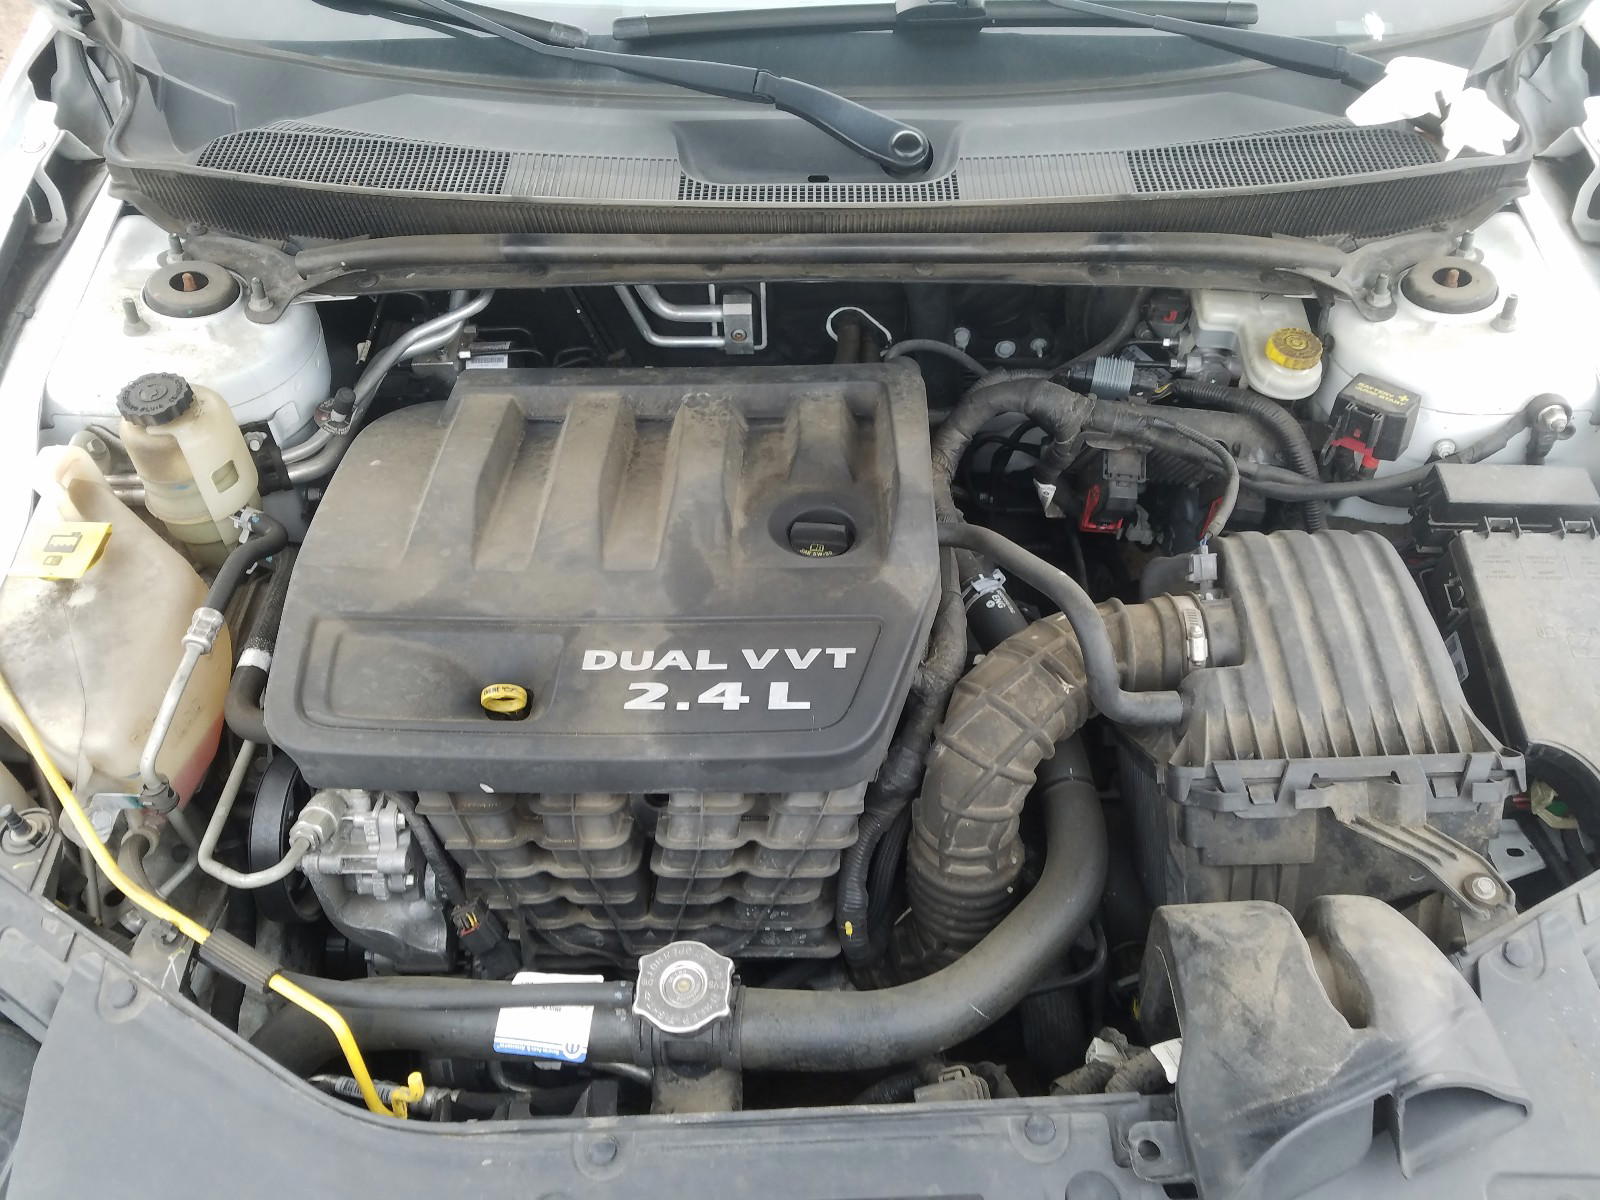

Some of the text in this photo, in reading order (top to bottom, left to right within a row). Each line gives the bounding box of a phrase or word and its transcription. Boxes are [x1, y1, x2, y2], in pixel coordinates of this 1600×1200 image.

[1356, 382, 1394, 398] BATTERY
[1377, 391, 1407, 406] START
[582, 647, 856, 671] DUAL VVT
